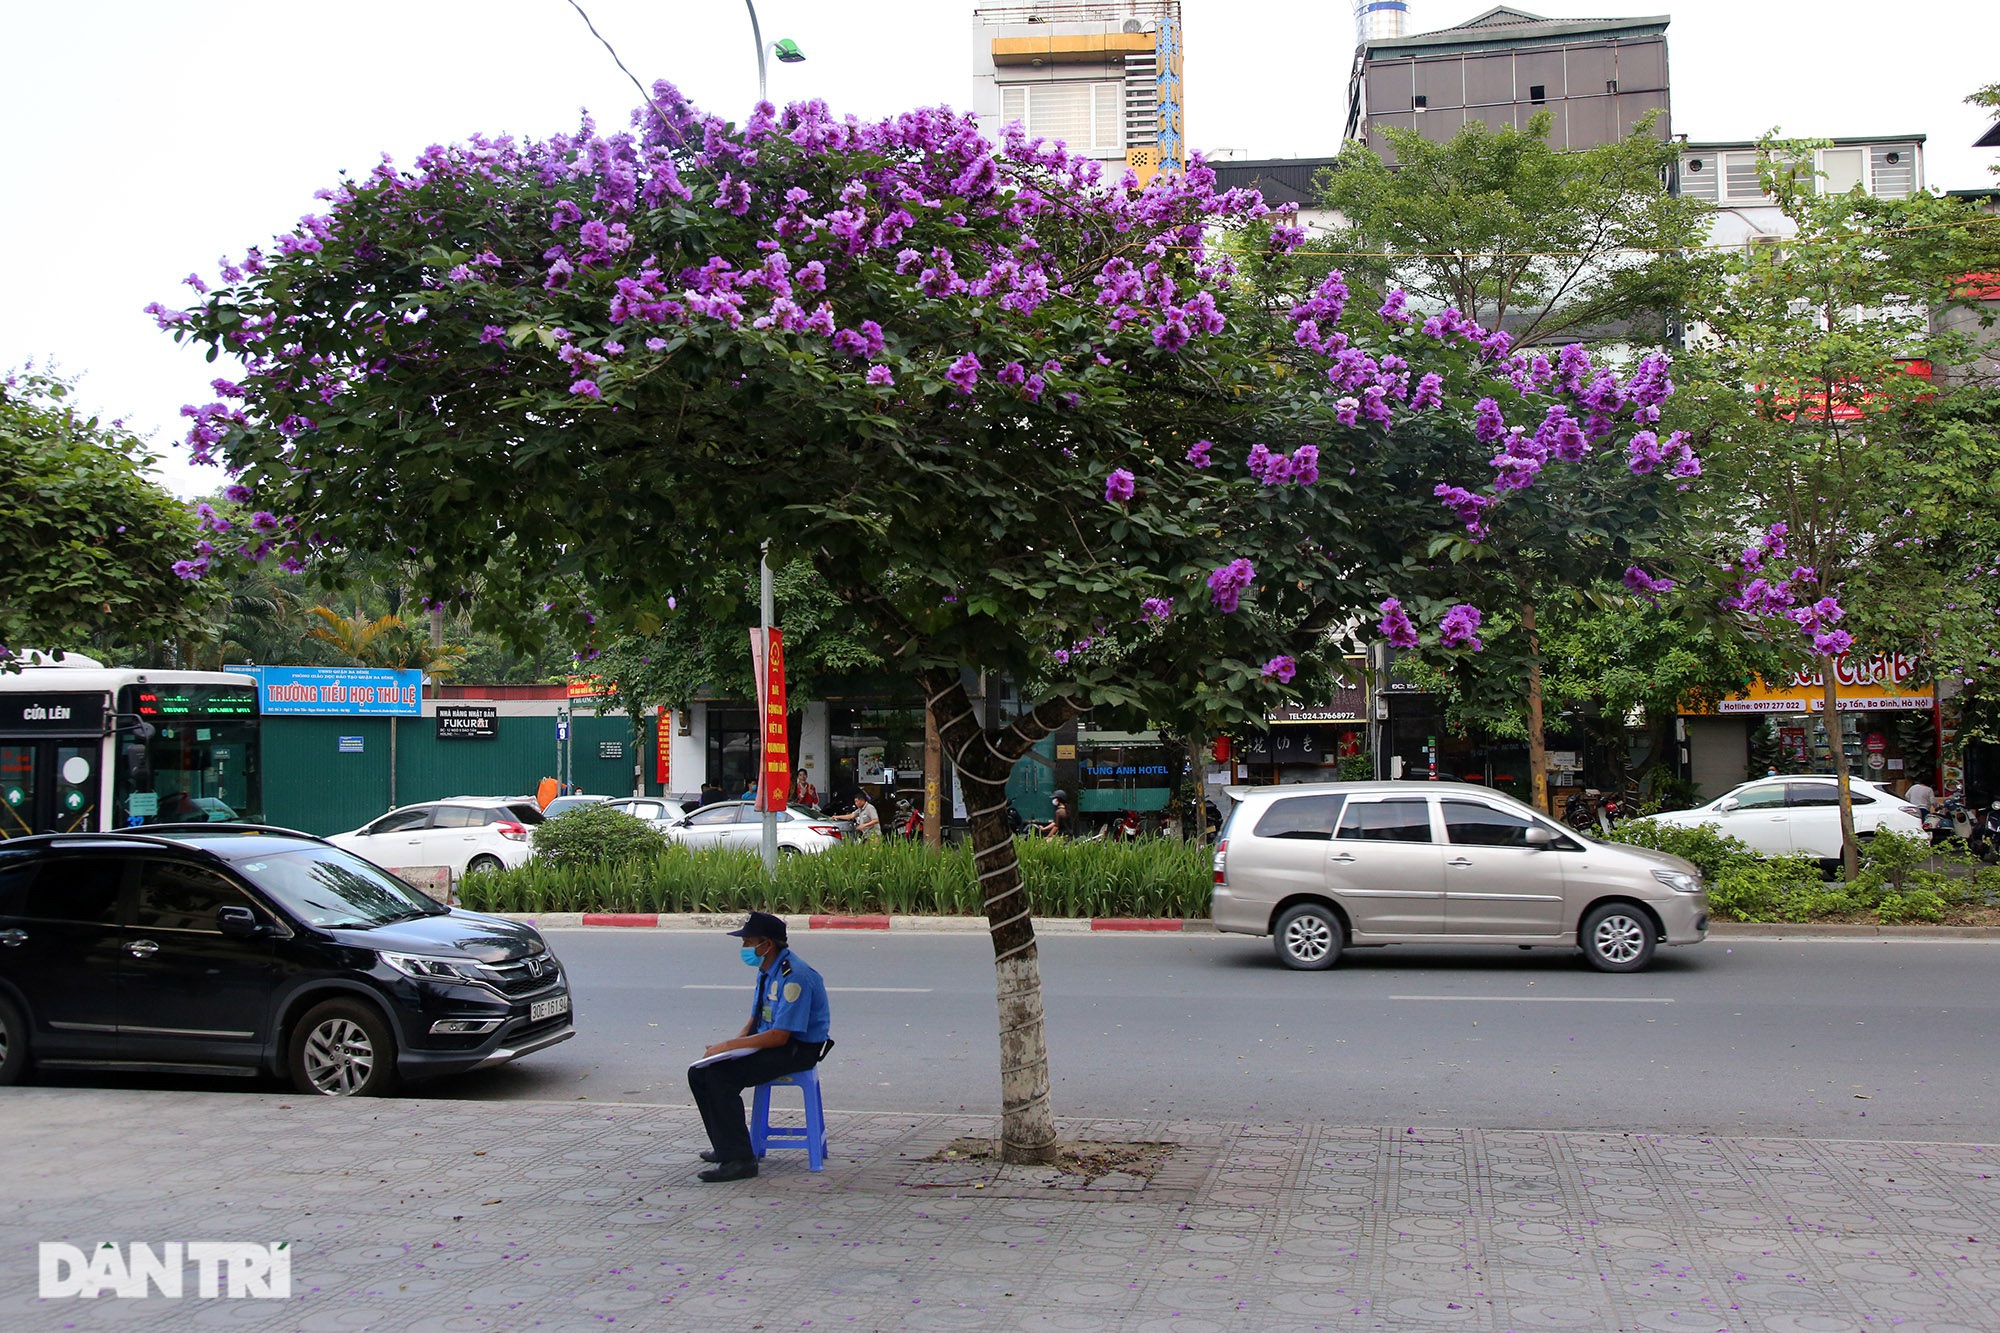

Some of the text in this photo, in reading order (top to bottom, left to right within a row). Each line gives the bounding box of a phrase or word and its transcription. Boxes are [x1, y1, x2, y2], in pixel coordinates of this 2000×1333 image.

[268, 680, 417, 707] TRƯỜNG TIỂU HỌC THỦ LỆ
[1753, 702, 1770, 710] 0917
[1786, 701, 1800, 709] 022
[1849, 699, 1866, 709] Tấn,
[1867, 700, 1878, 708] Ba
[1880, 699, 1900, 708] Đình,
[1901, 699, 1913, 707] Hà
[1915, 699, 1928, 708] Nội
[23, 703, 71, 720] CỬA LÊN
[559, 729, 566, 740] 9
[1087, 766, 1169, 775] TUNG ANH HOTEL
